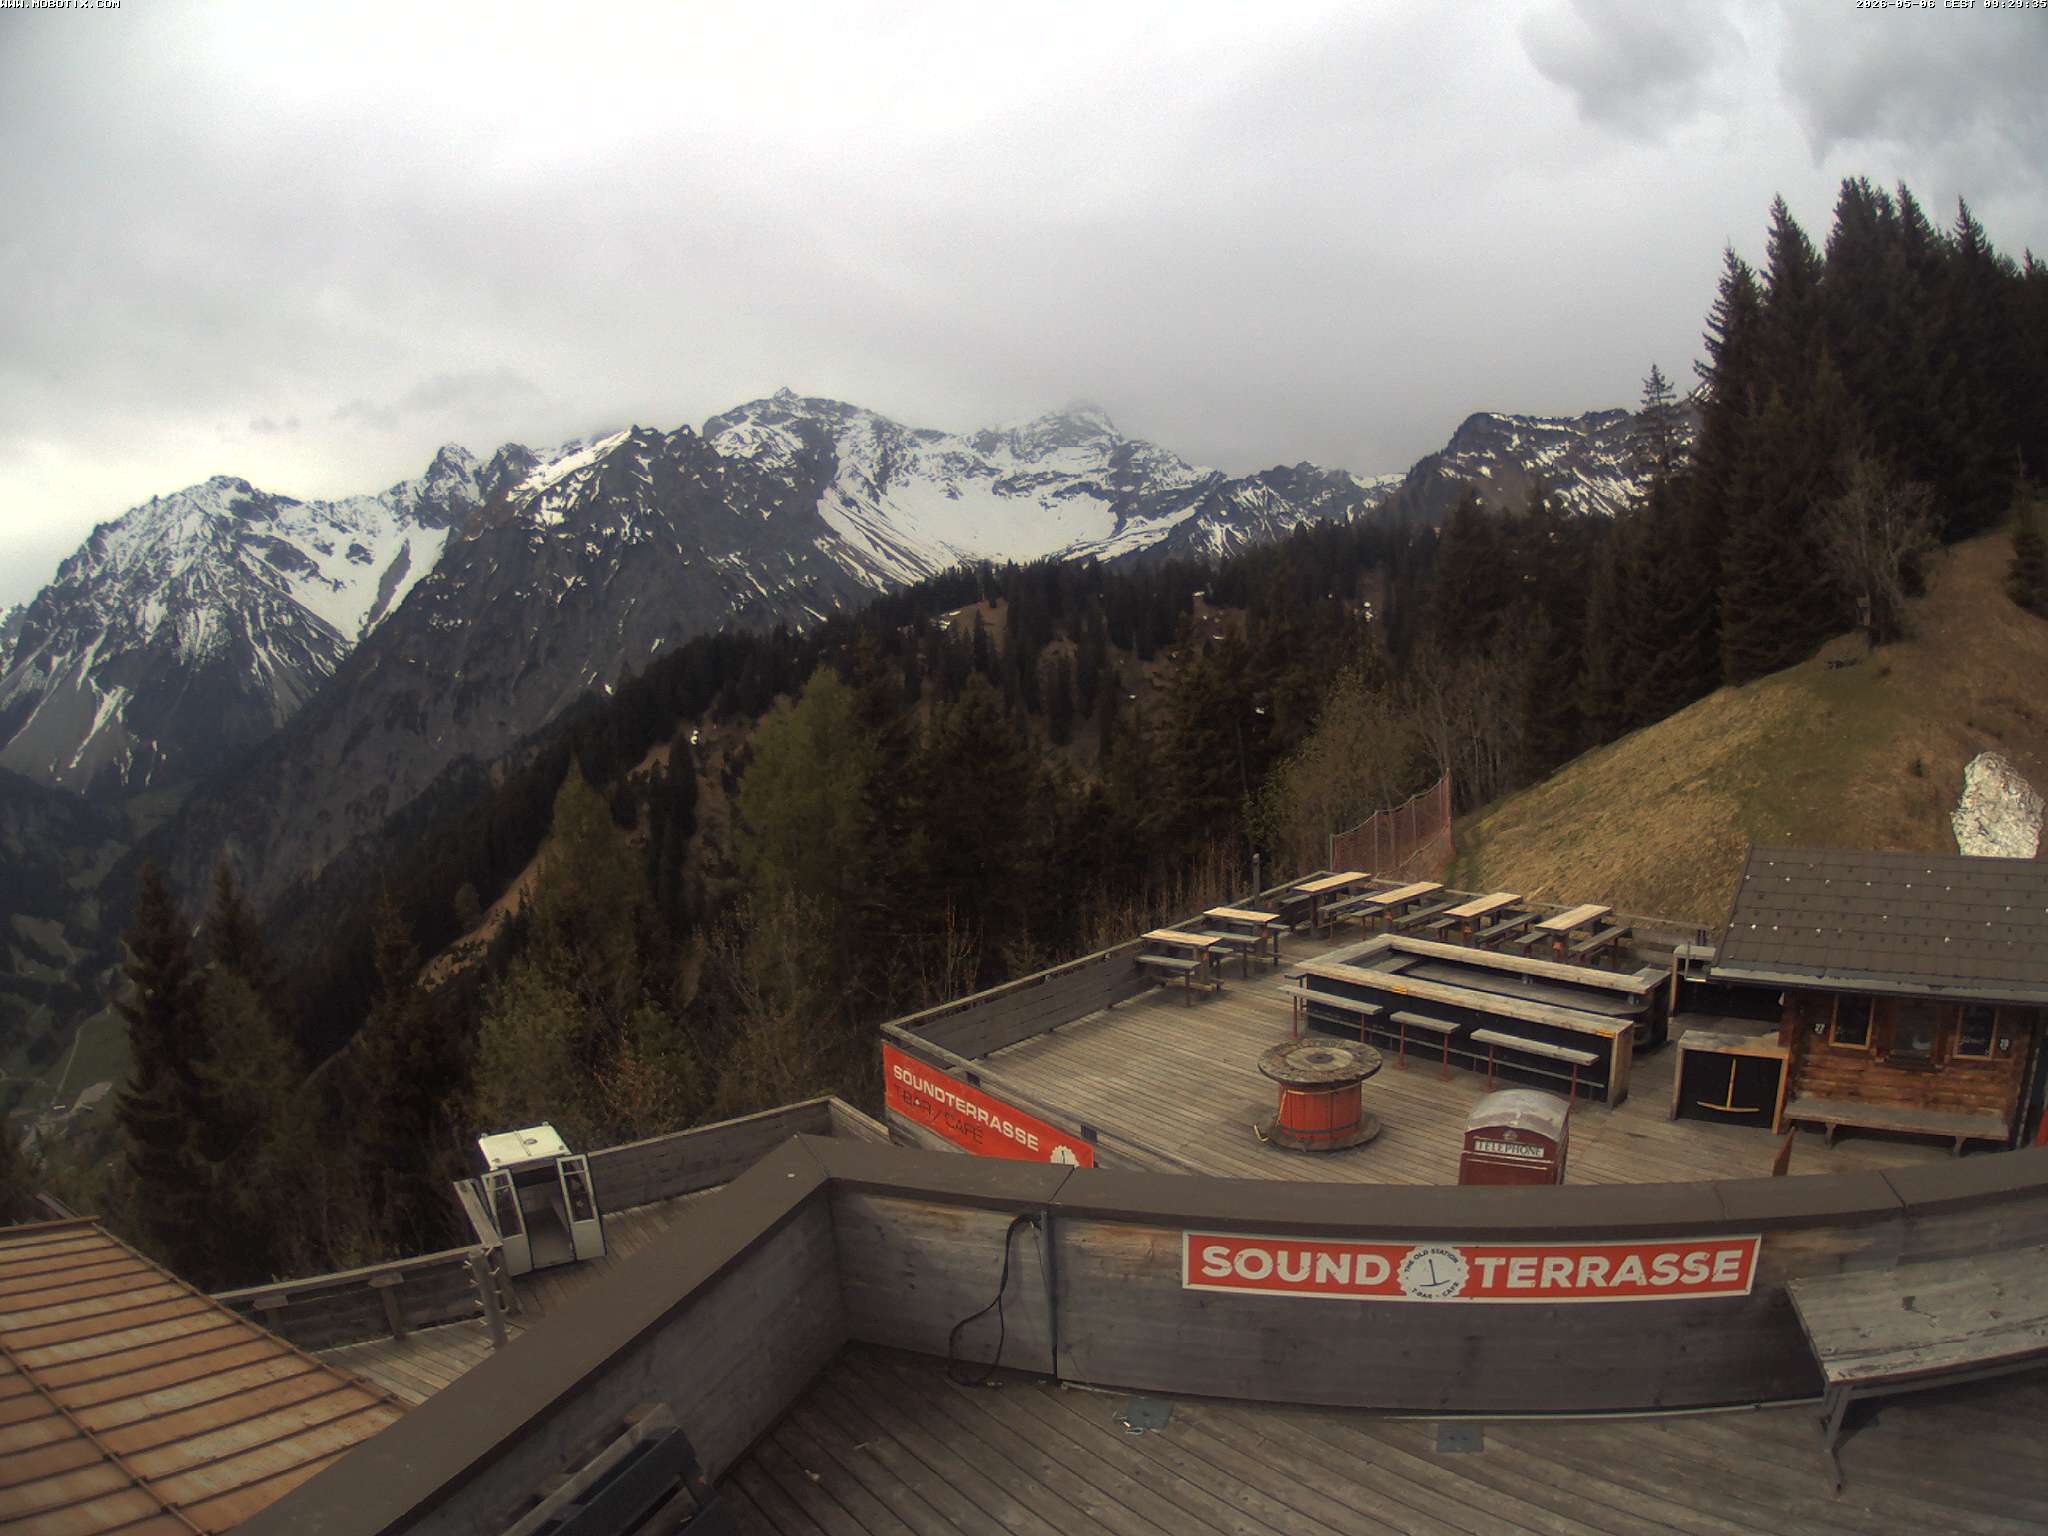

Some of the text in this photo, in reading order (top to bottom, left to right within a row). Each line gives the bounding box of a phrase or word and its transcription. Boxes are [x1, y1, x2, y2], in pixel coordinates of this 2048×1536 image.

[893, 1064, 1040, 1152] SOUNDTERRASSE
[1477, 1141, 1541, 1156] TELEPHONE
[1200, 1245, 1744, 1289] SOUND TERRASSE
[1413, 1248, 1429, 1260] OLD
[1431, 1248, 1460, 1264] STATION
